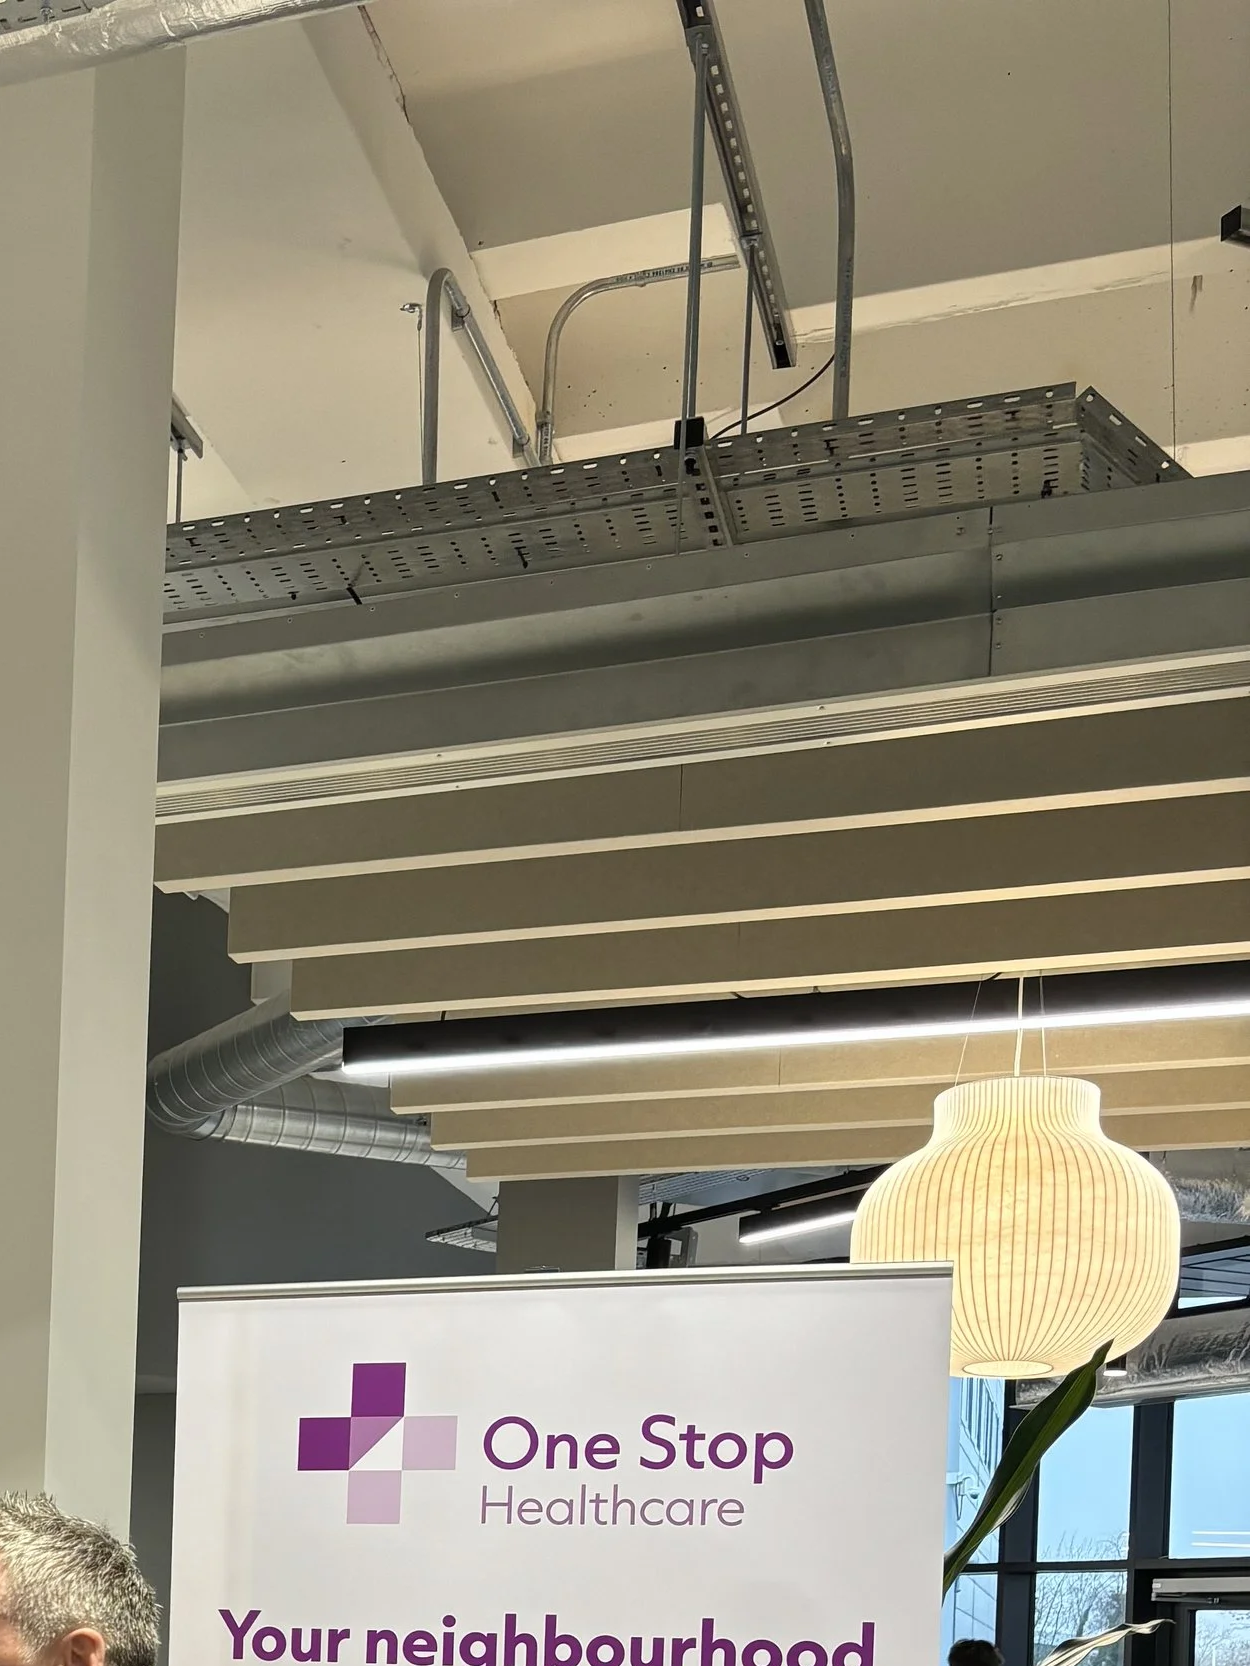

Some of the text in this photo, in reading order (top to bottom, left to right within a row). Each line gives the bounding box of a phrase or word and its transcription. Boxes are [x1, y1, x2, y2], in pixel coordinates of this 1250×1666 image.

[483, 1413, 794, 1484] One Stop
[480, 1484, 745, 1527] Healthcare
[218, 1608, 351, 1663] Your
